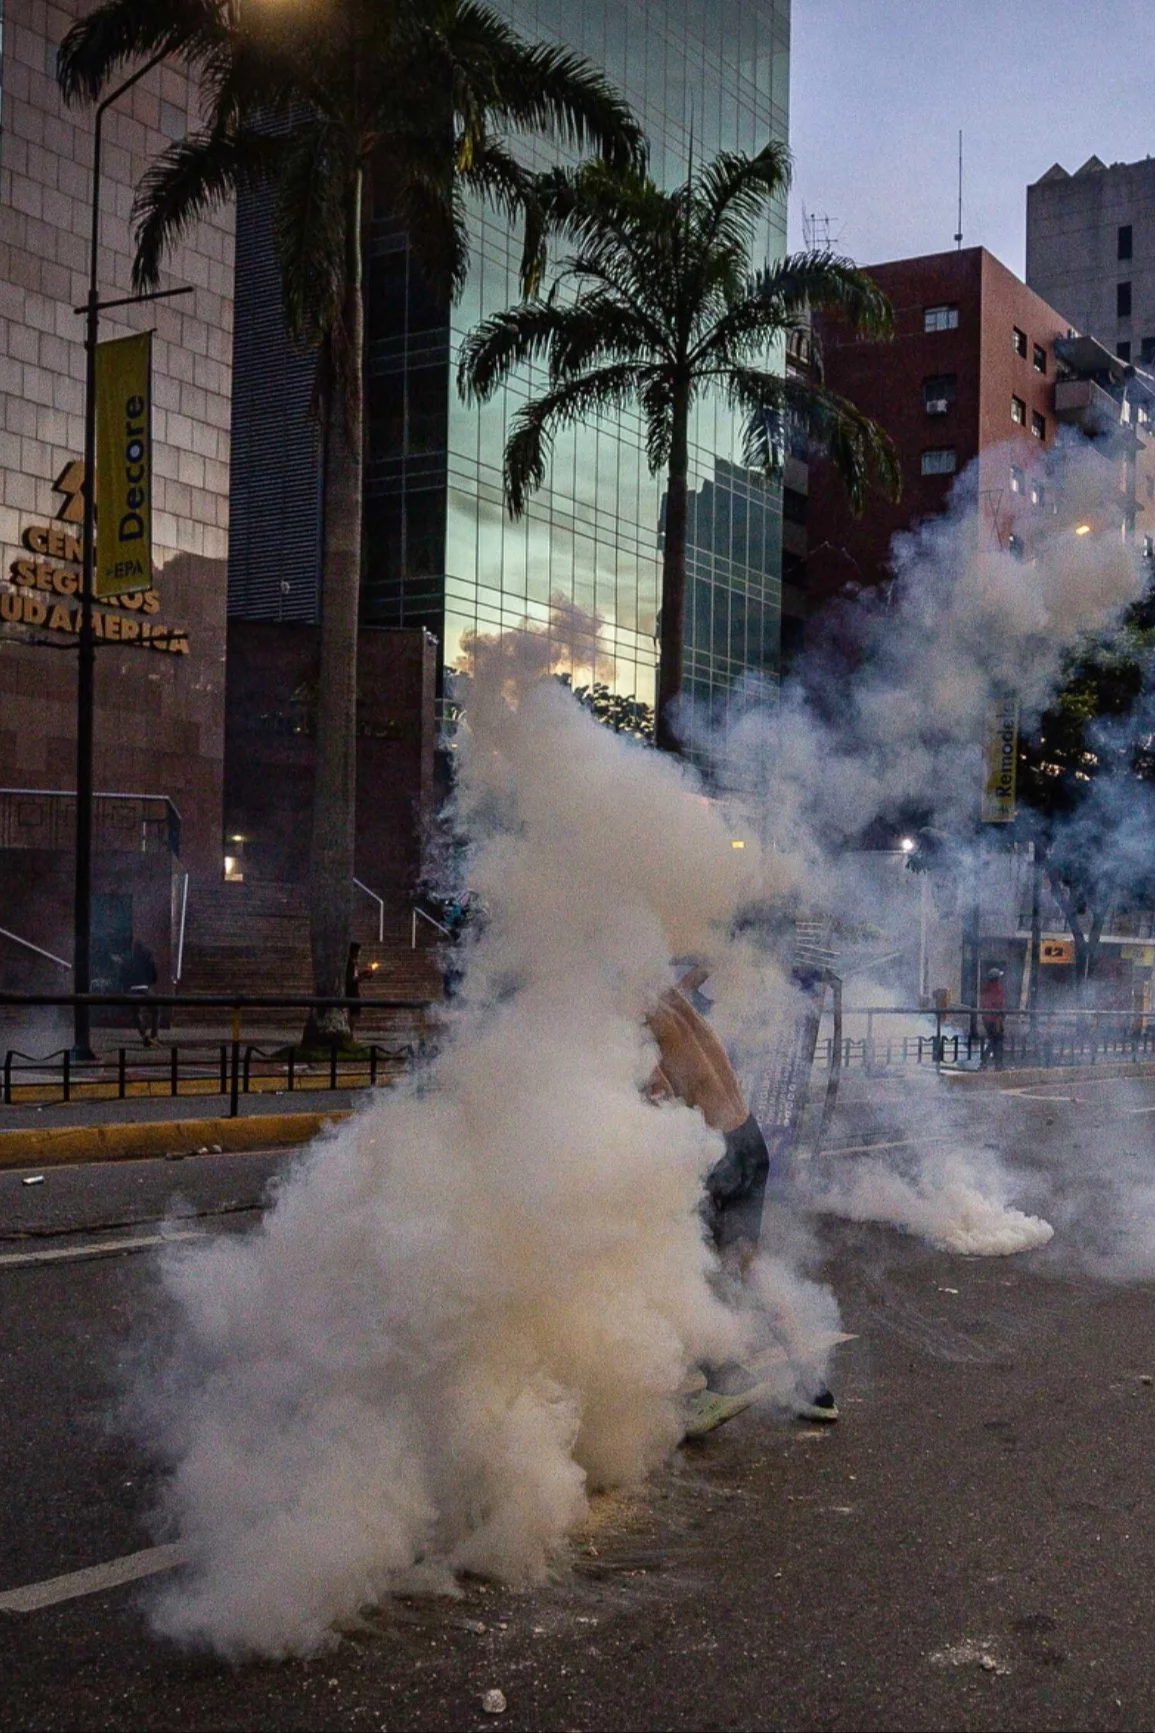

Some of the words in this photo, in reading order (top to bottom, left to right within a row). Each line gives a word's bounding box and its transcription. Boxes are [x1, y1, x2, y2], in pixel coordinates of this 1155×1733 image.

[119, 395, 144, 542] Decore
[12, 560, 161, 615] SEGOS
[114, 559, 144, 578] EPA
[0, 593, 190, 654] UDAMERICA
